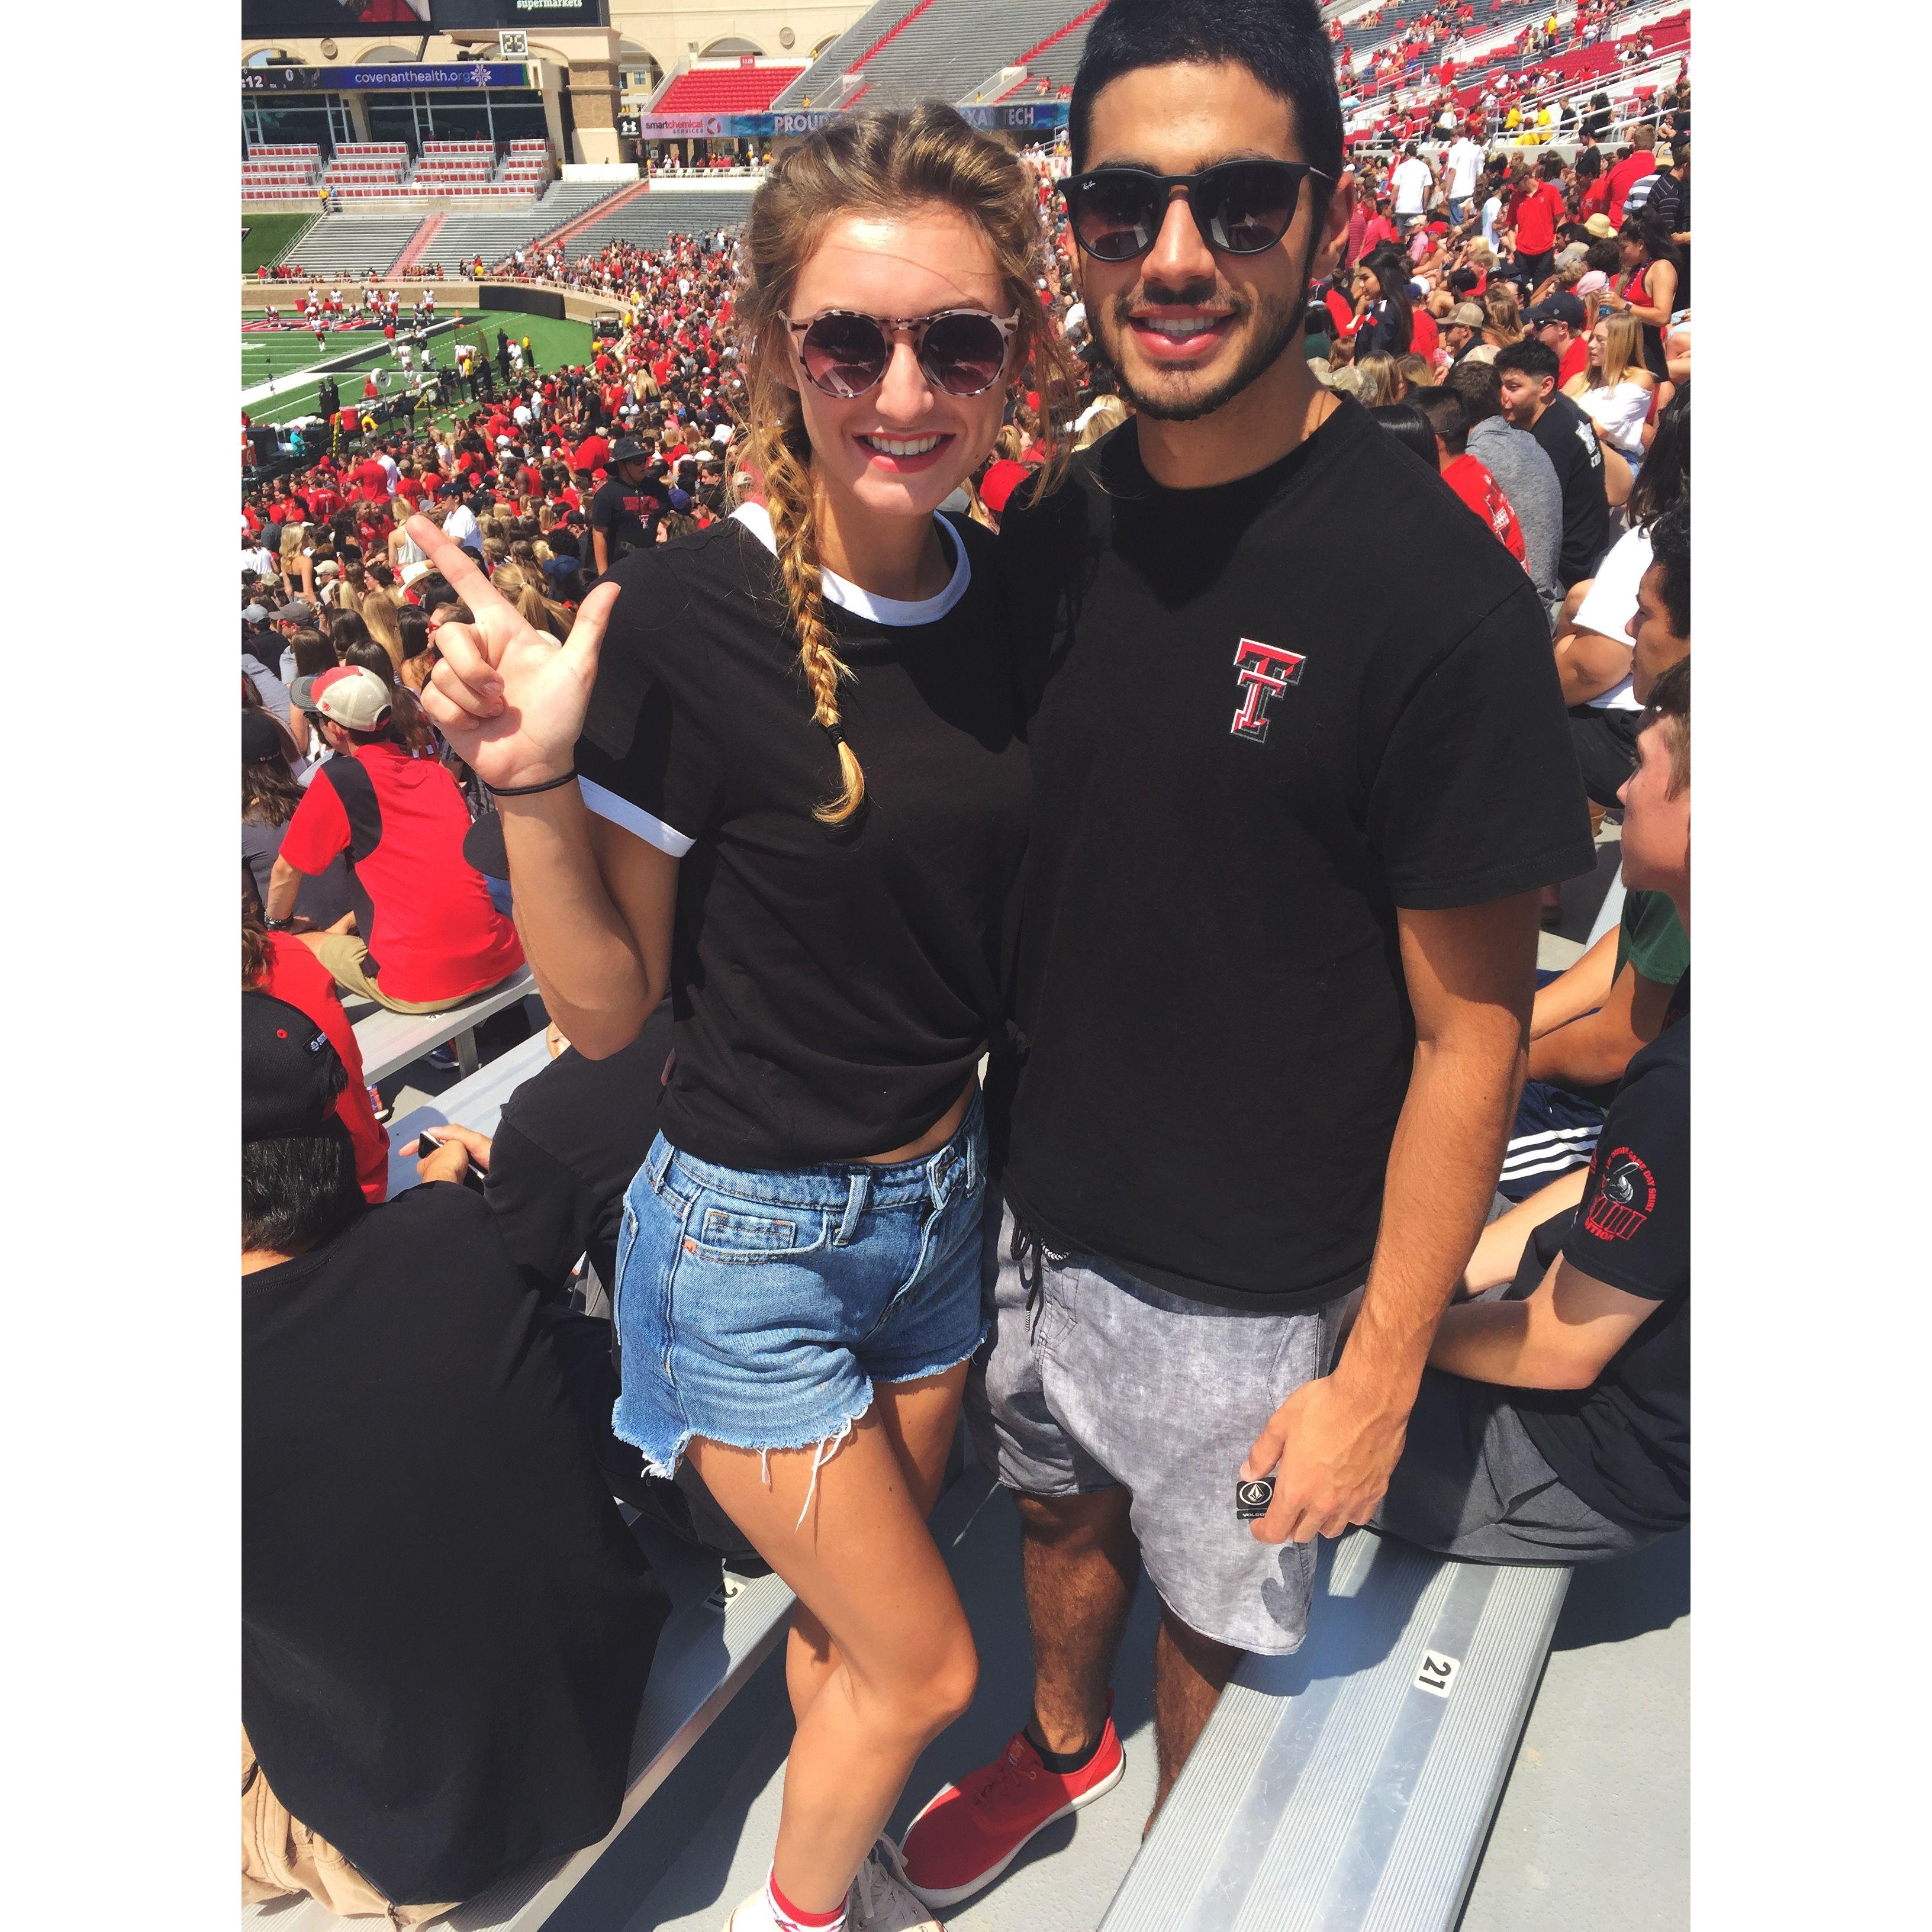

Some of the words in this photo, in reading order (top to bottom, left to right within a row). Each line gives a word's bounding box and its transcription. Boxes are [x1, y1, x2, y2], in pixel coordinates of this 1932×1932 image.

[517, 0, 582, 10] supermarkets
[504, 34, 525, 52] 25
[285, 69, 291, 81] 0
[355, 69, 471, 83] covenanthealth.org
[1005, 107, 1035, 125] ECH
[1644, 1170, 1655, 1187] DAY
[1644, 1188, 1657, 1213] SHIRT
[1418, 1655, 1452, 1690] 21
